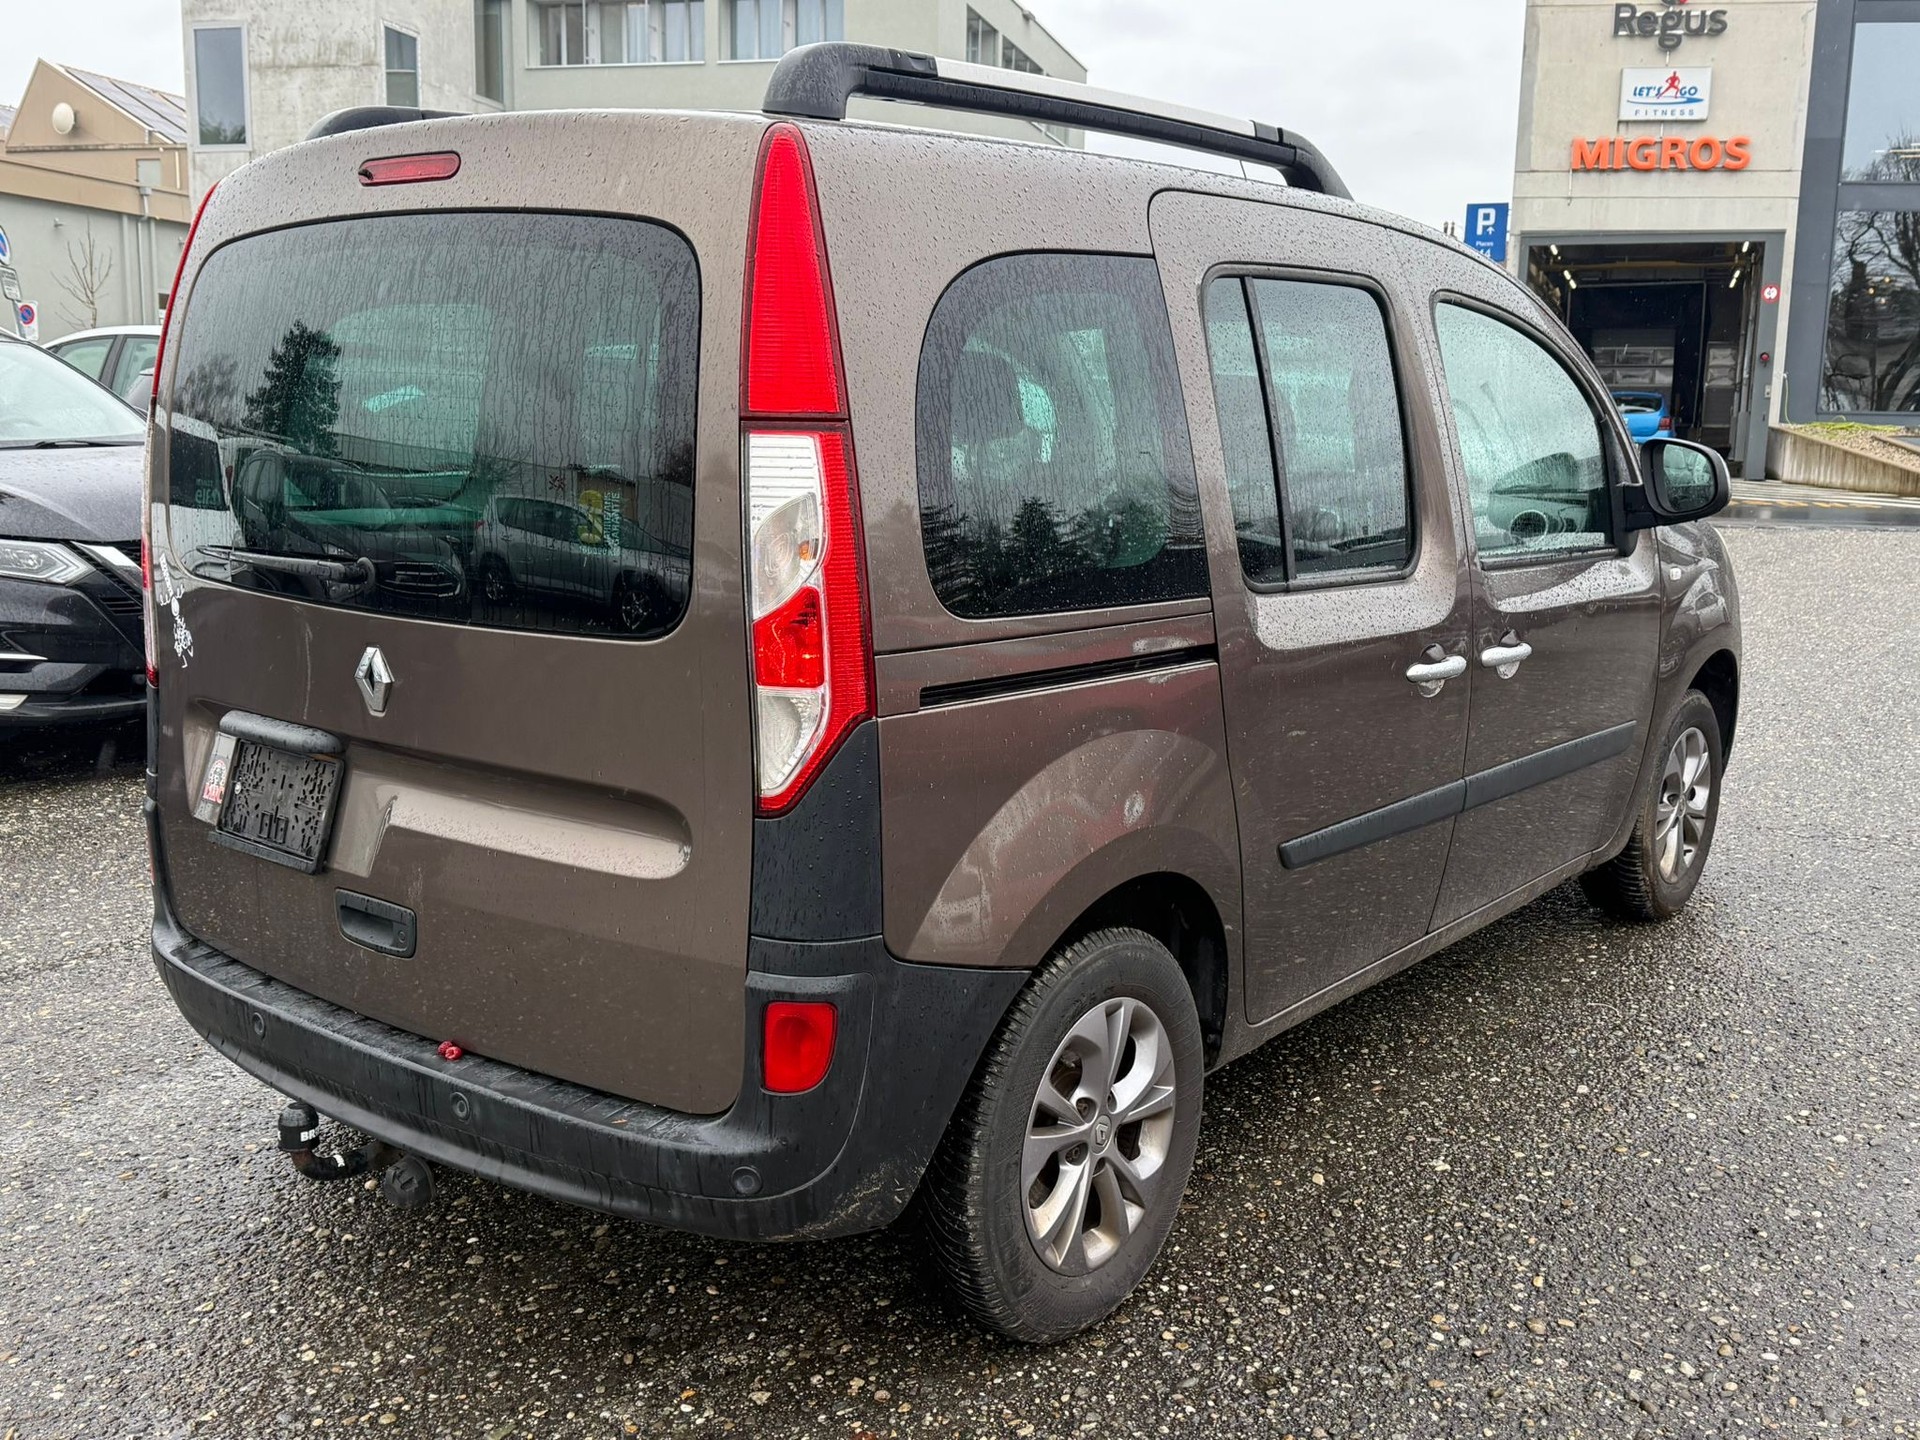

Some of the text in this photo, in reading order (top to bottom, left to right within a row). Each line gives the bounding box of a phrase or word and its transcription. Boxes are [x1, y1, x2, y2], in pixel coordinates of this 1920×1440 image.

[1613, 3, 1728, 50] Regus
[1633, 86, 1698, 97] LET'S GO
[1634, 109, 1695, 117] FITNESS
[1570, 136, 1752, 171] MIGROS
[1476, 207, 1496, 236] P
